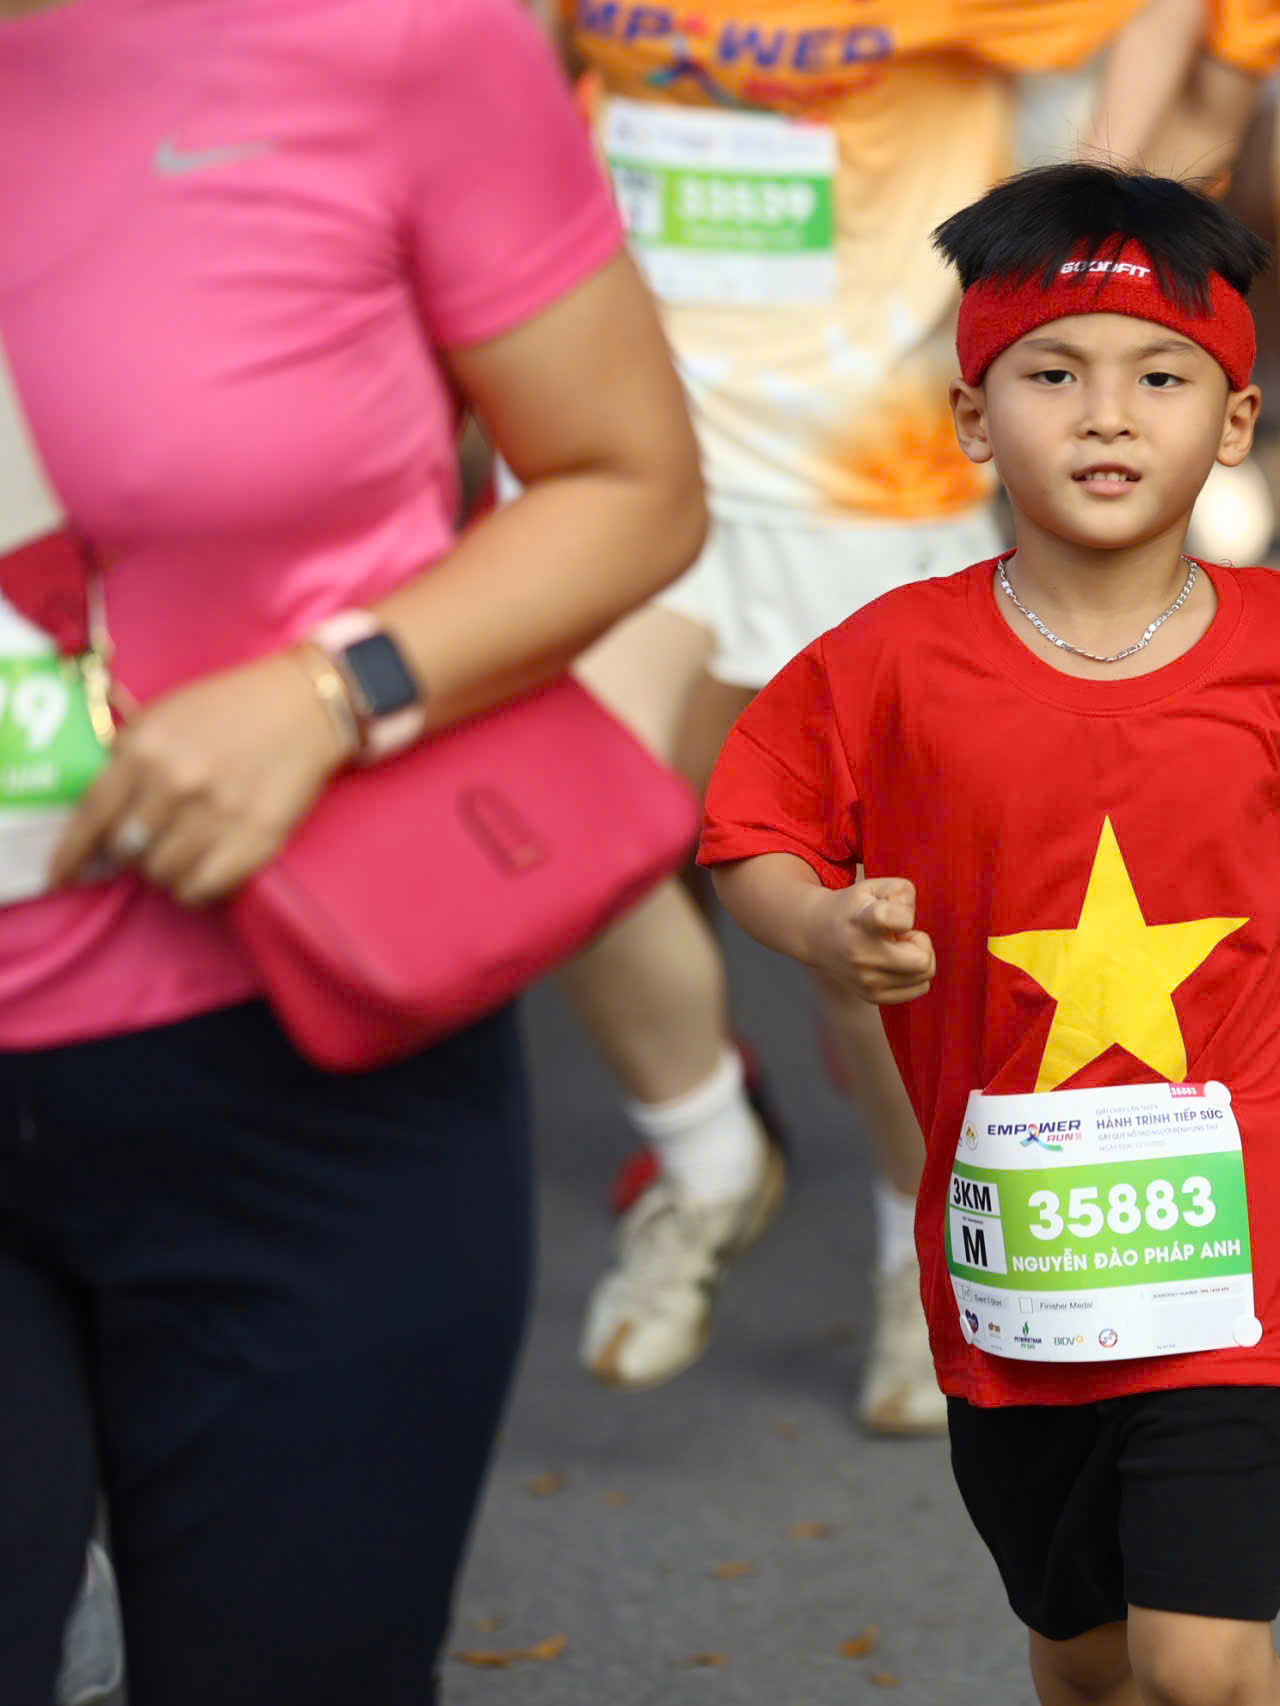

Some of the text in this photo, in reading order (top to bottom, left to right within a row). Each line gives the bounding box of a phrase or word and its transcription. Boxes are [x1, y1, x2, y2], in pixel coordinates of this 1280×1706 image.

[987, 1119, 1082, 1136] EMPOWER
[1096, 1115, 1132, 1130] HÀNH
[1135, 1112, 1171, 1126] TRÌNH
[1173, 1107, 1197, 1122] TIẾP
[1199, 1107, 1224, 1120] SỨC
[1047, 1132, 1074, 1143] RUN
[953, 1177, 993, 1213] 3KM
[1028, 1175, 1217, 1241] 35883
[962, 1225, 989, 1268] M
[1012, 1239, 1241, 1273] NGUYỄN ĐÀO PHÁP ANH
[1040, 1300, 1094, 1310] Finisher Medal
